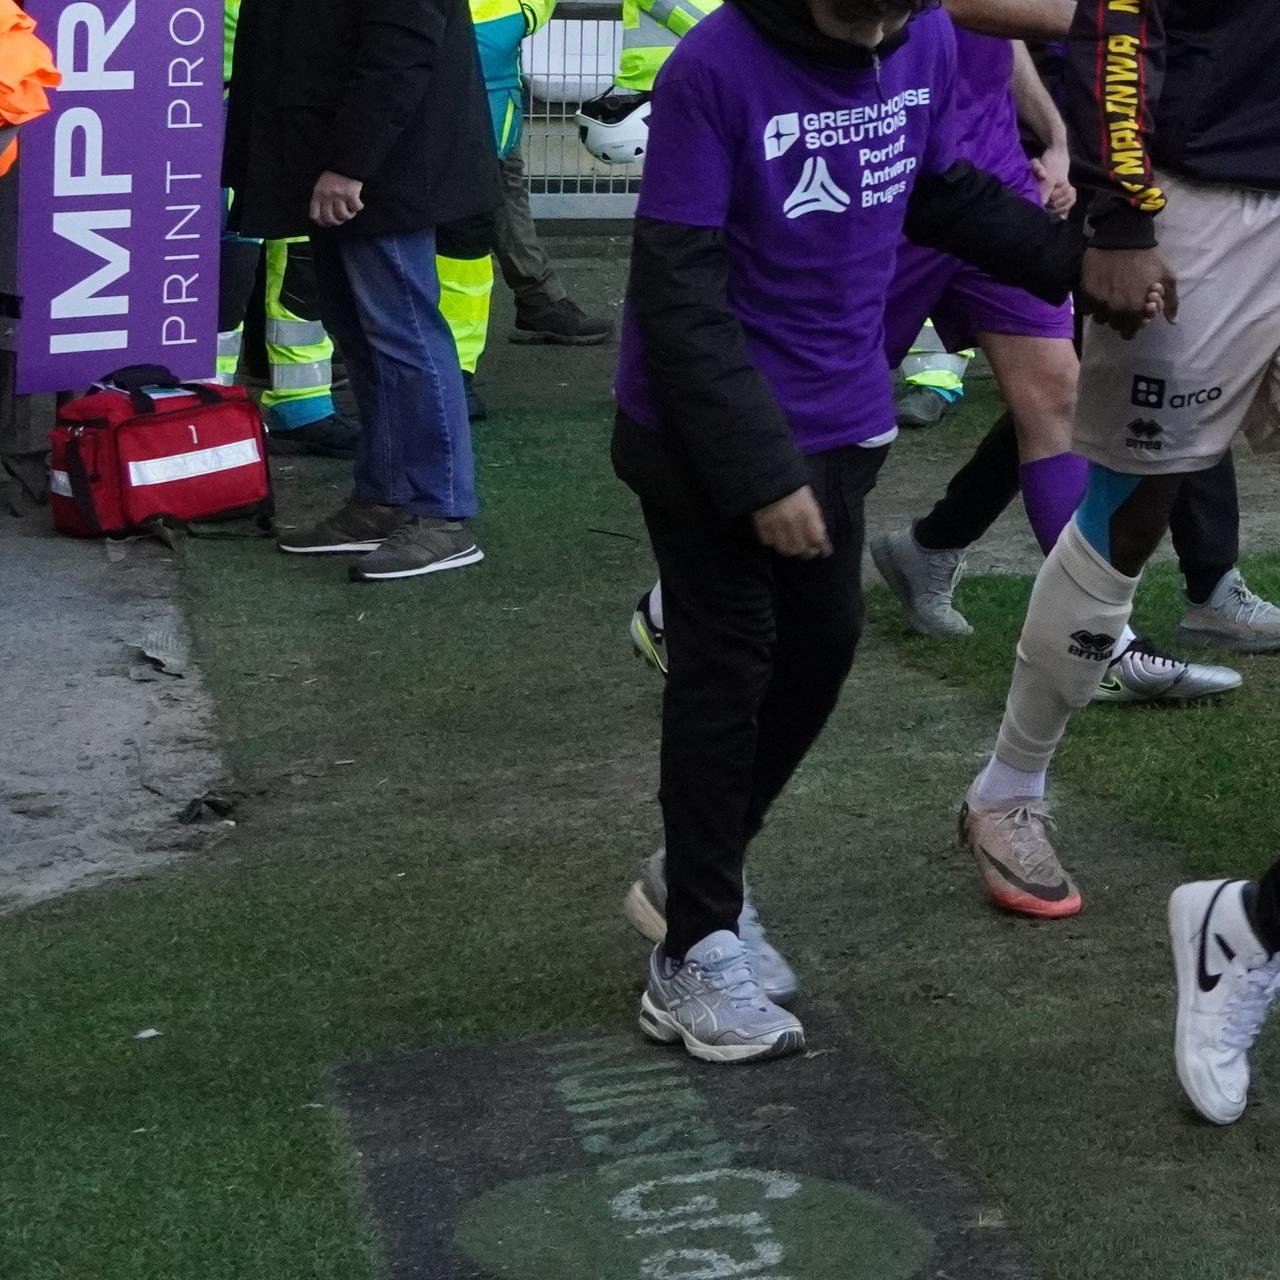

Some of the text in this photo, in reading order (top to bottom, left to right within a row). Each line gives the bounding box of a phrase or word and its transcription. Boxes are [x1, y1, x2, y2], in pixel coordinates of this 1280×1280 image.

[803, 88, 930, 131] GREEN HOUSE
[1105, 33, 1144, 176] MALINWA
[805, 110, 907, 150] SOLUTIONS
[859, 134, 906, 166] Port of
[861, 156, 916, 187] Antwerp
[861, 180, 907, 208] Bruges
[162, 160, 202, 345] PRINT
[1170, 386, 1222, 409] arco
[187, 424, 199, 444] 1
